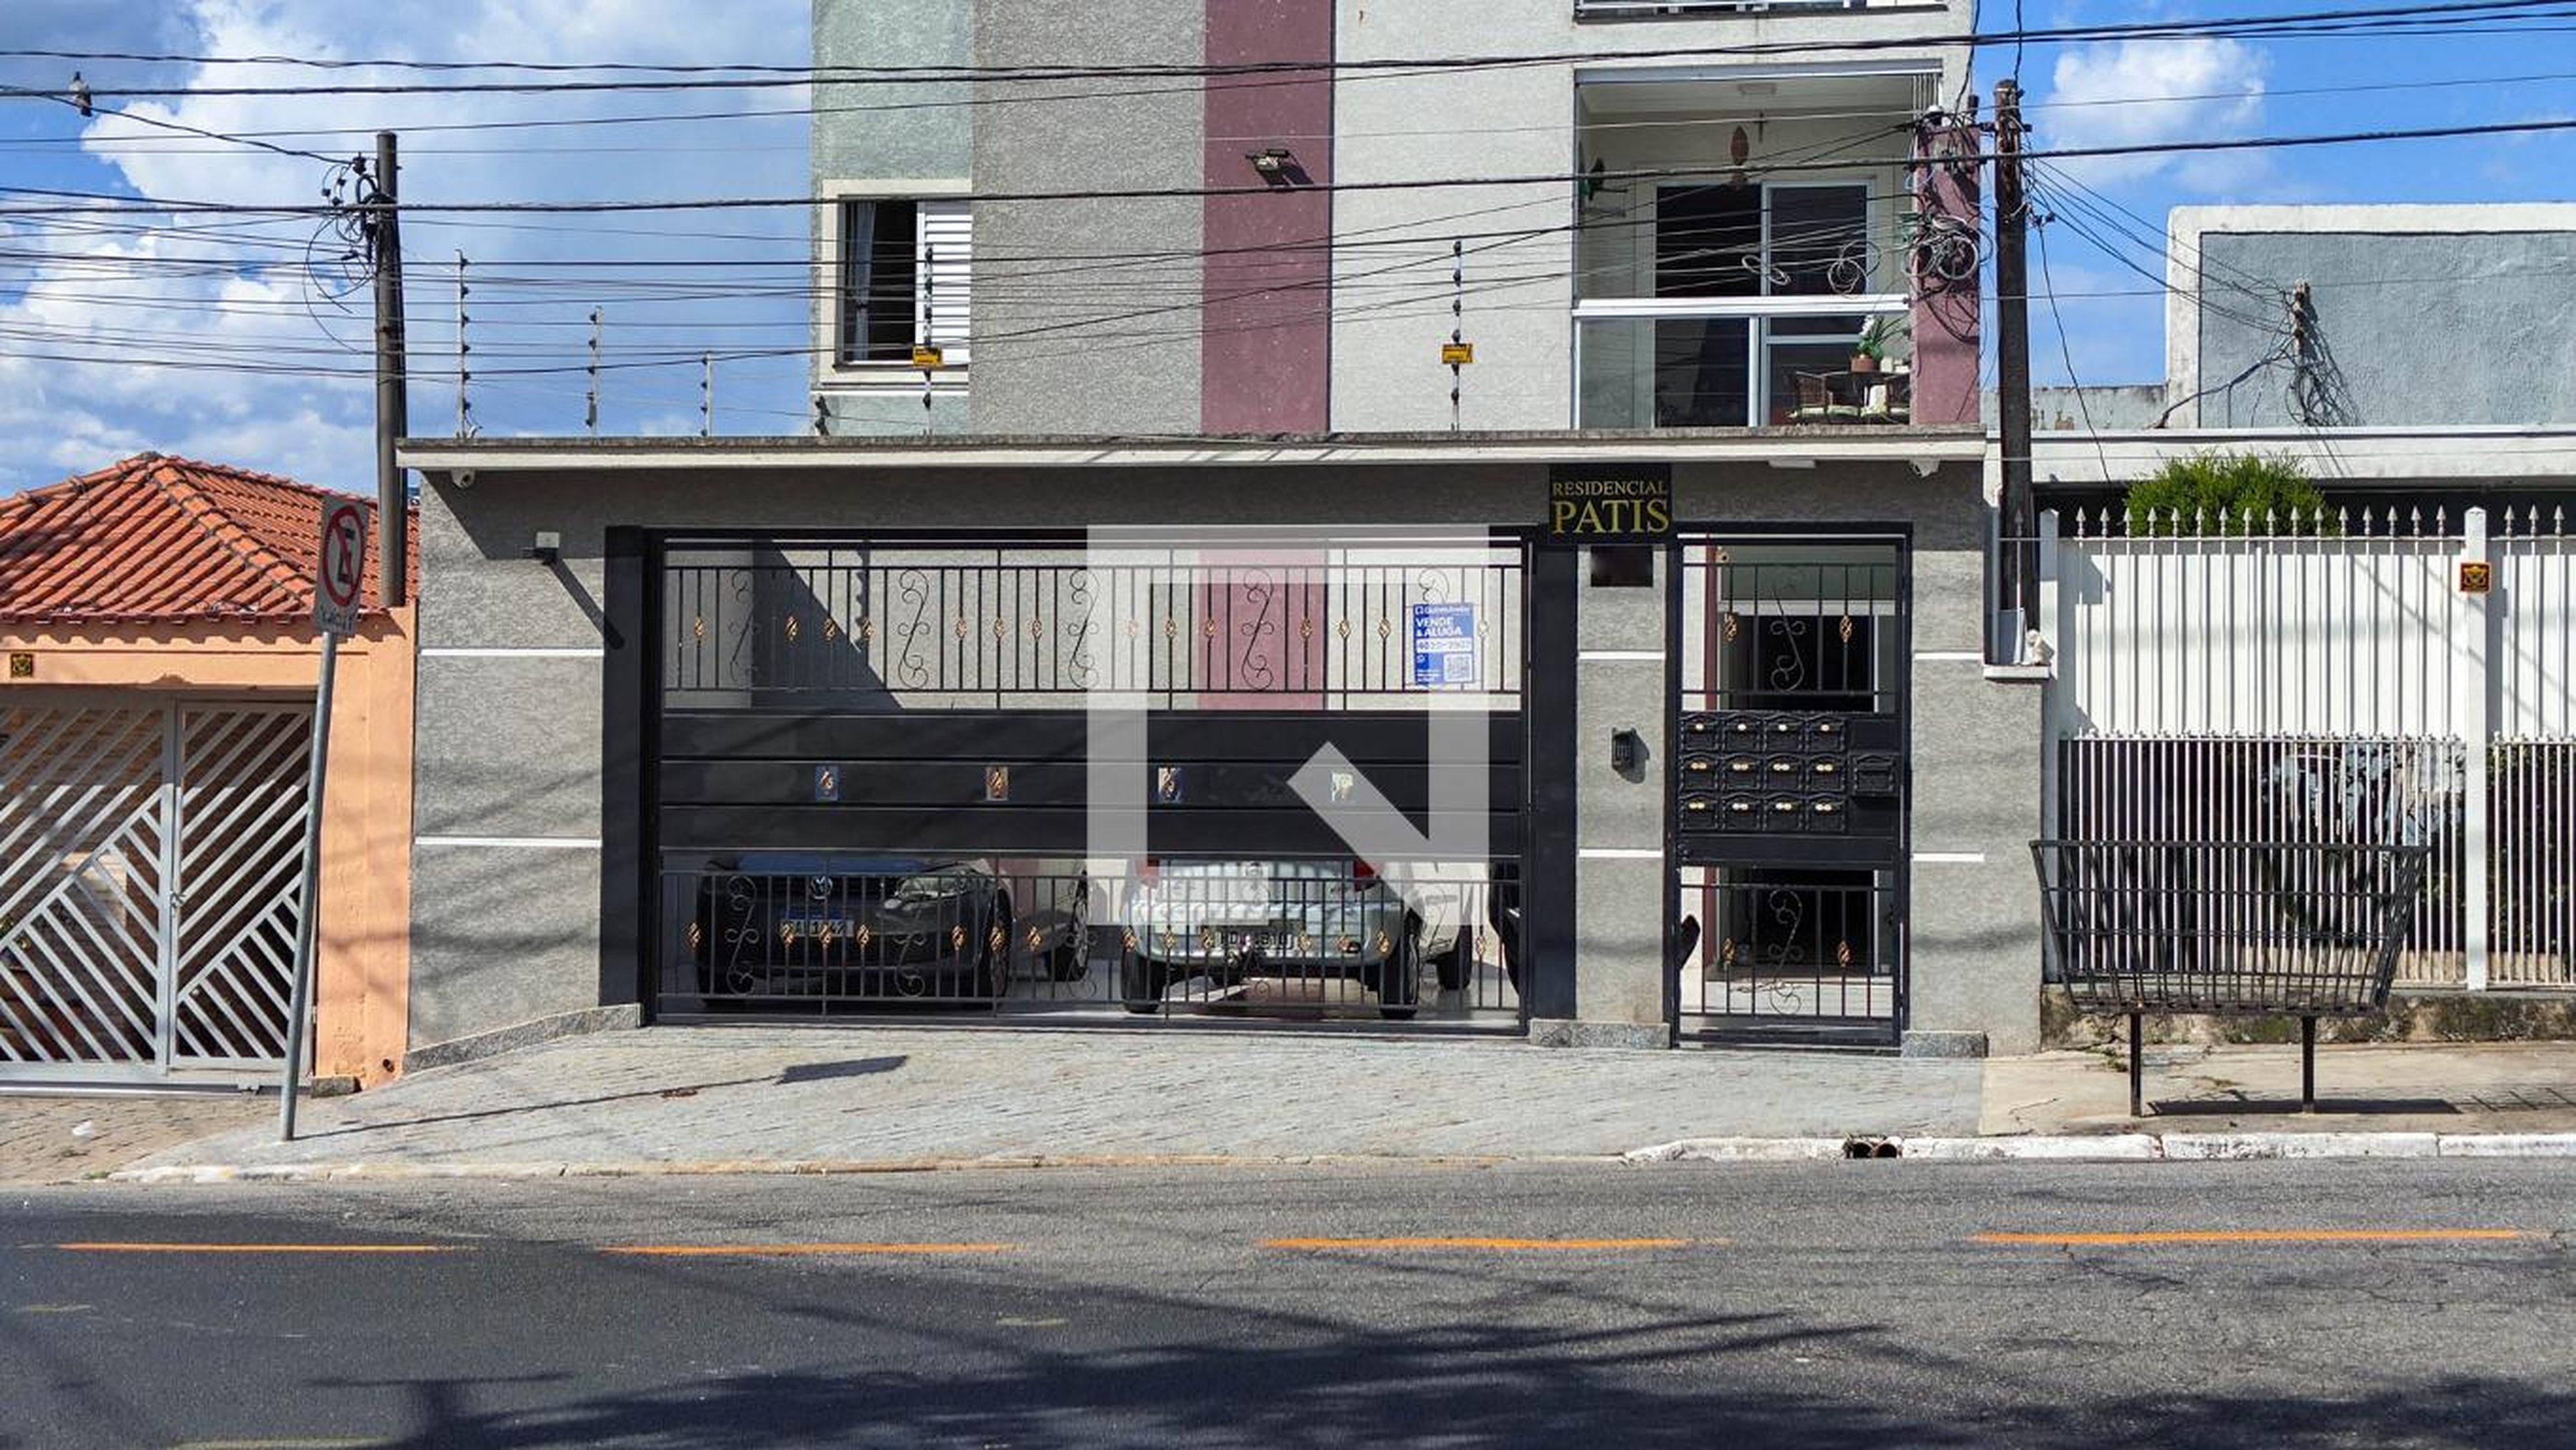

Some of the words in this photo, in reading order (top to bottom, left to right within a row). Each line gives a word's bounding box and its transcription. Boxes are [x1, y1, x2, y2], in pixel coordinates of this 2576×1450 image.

[1552, 480, 1668, 496] RESIDENCIAL
[1551, 499, 1670, 534] PATIS
[1415, 617, 1454, 627] VENDE
[1424, 627, 1463, 637] ALUGA
